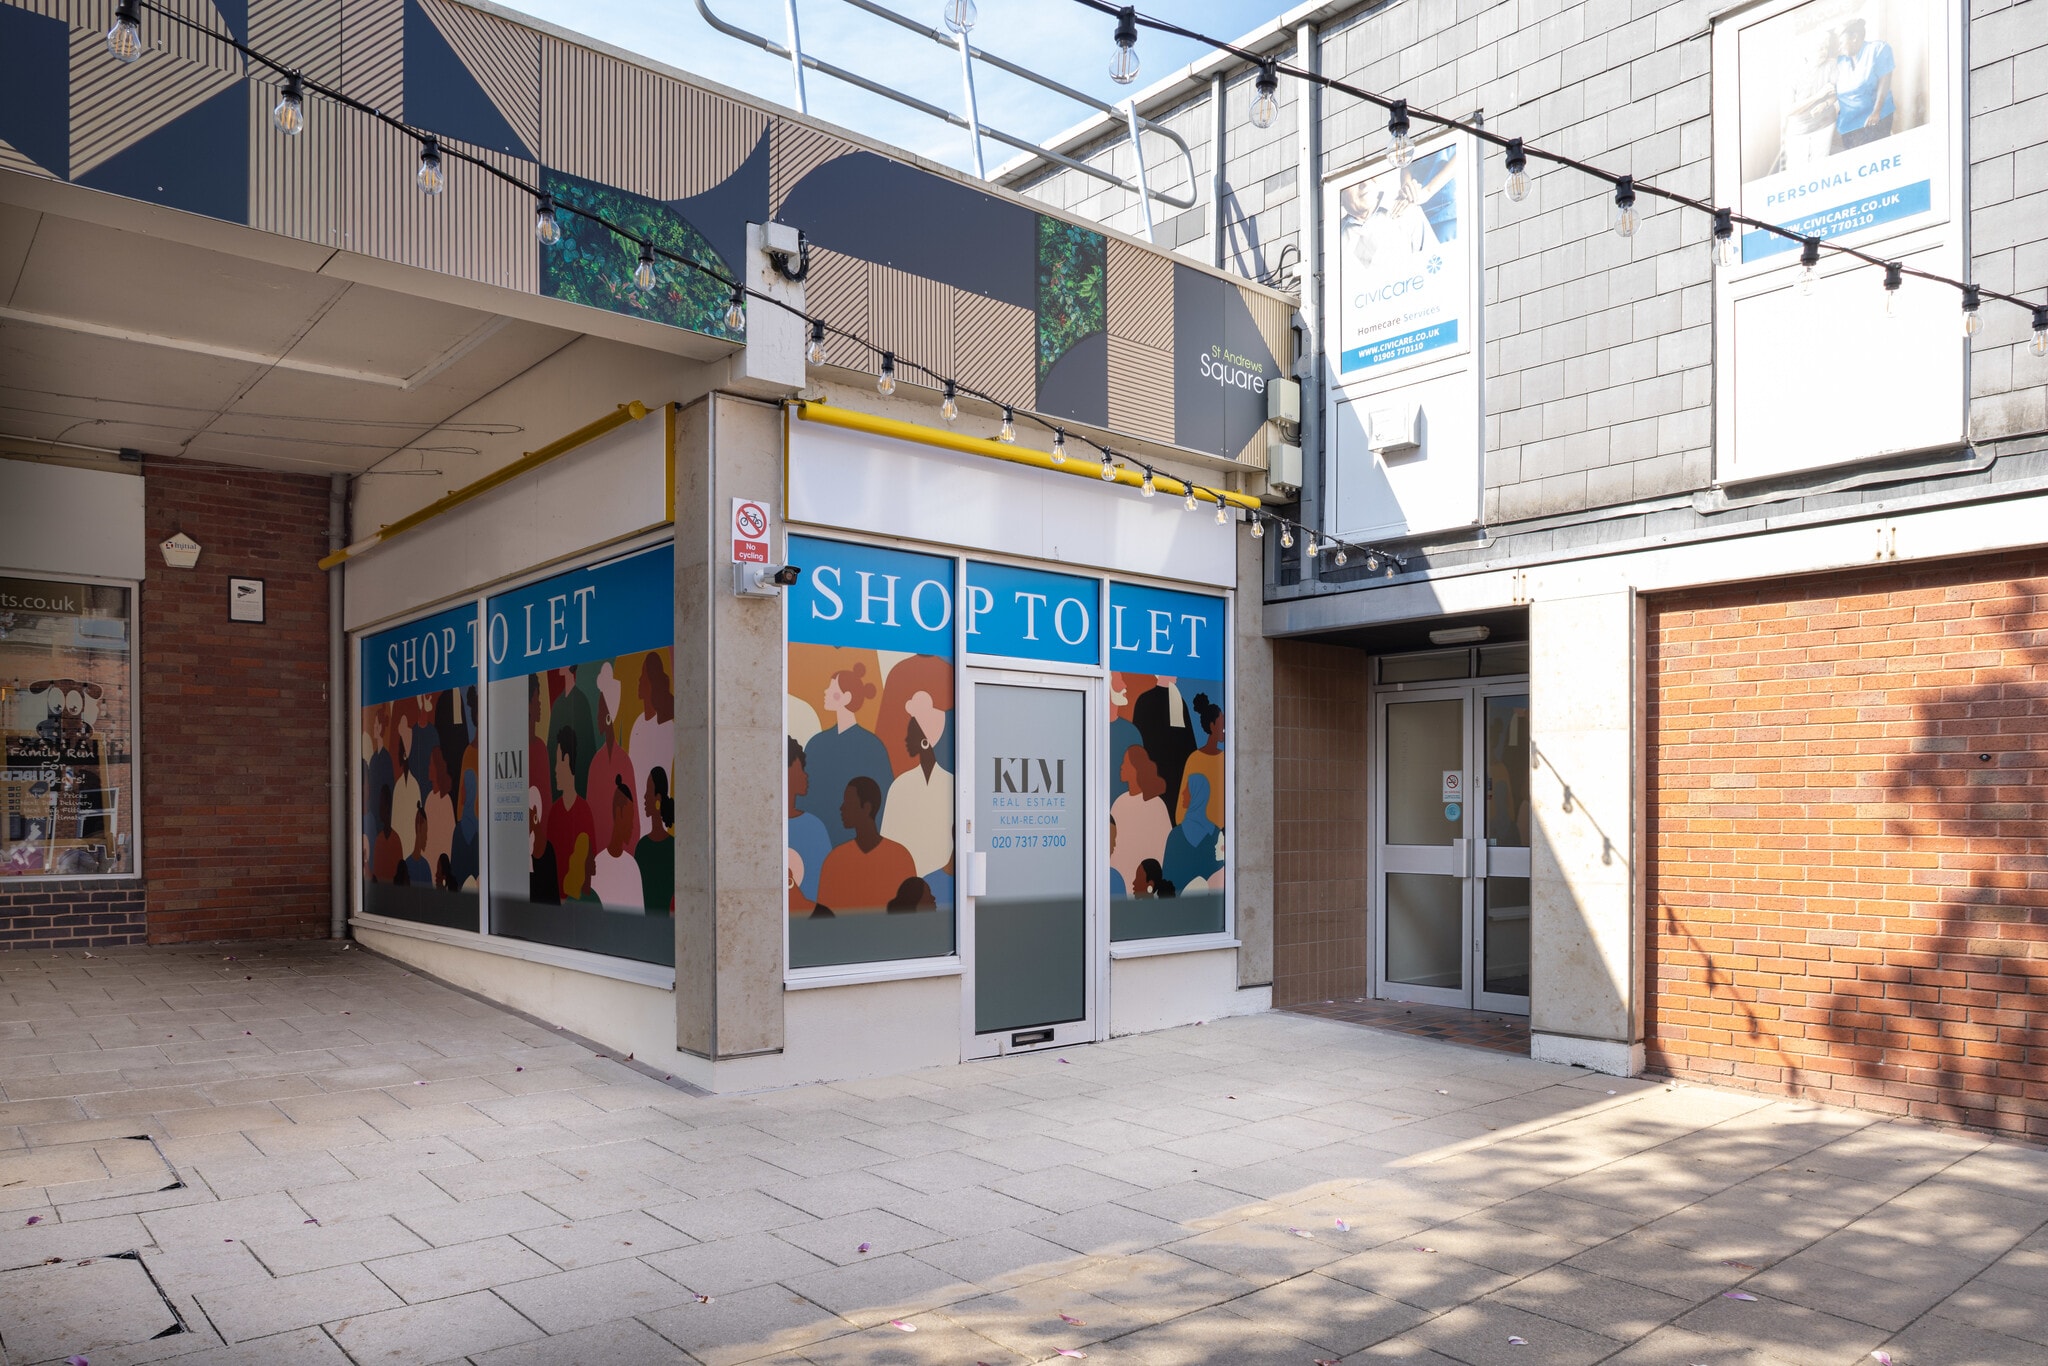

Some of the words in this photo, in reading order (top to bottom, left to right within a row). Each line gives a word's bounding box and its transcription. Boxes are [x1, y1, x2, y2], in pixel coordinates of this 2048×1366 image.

[1766, 171, 1853, 207] PERSONAL
[1857, 154, 1903, 178] CARE
[1830, 213, 1874, 234] 770110
[1357, 317, 1401, 336] Homecare
[1403, 305, 1441, 323] Services
[1358, 328, 1441, 358] WWW.CIVICARE.CO.UK
[1373, 349, 1396, 363] 01905
[1397, 342, 1424, 357] 770110
[1211, 344, 1222, 358] St
[1223, 348, 1264, 374] Andrews
[1200, 353, 1265, 394] Square
[738, 551, 764, 562] cycling
[745, 542, 757, 551] No
[811, 565, 995, 636] SHOP
[1014, 591, 1091, 646] TO
[1110, 604, 1208, 659] LET
[387, 627, 457, 688] SHOP
[467, 612, 509, 668] TO
[523, 585, 597, 658] LET
[10, 747, 60, 763] Family
[67, 749, 95, 758] Run
[41, 762, 67, 771] For
[495, 750, 523, 780] KLM
[992, 756, 1067, 794] KLM
[992, 797, 1020, 807] REAL
[1027, 797, 1066, 807] ESTATE
[1000, 815, 1059, 825] KLM-RE.COM
[991, 835, 1012, 848] 020
[1015, 835, 1038, 848] 7317
[1042, 835, 1067, 848] 3700
